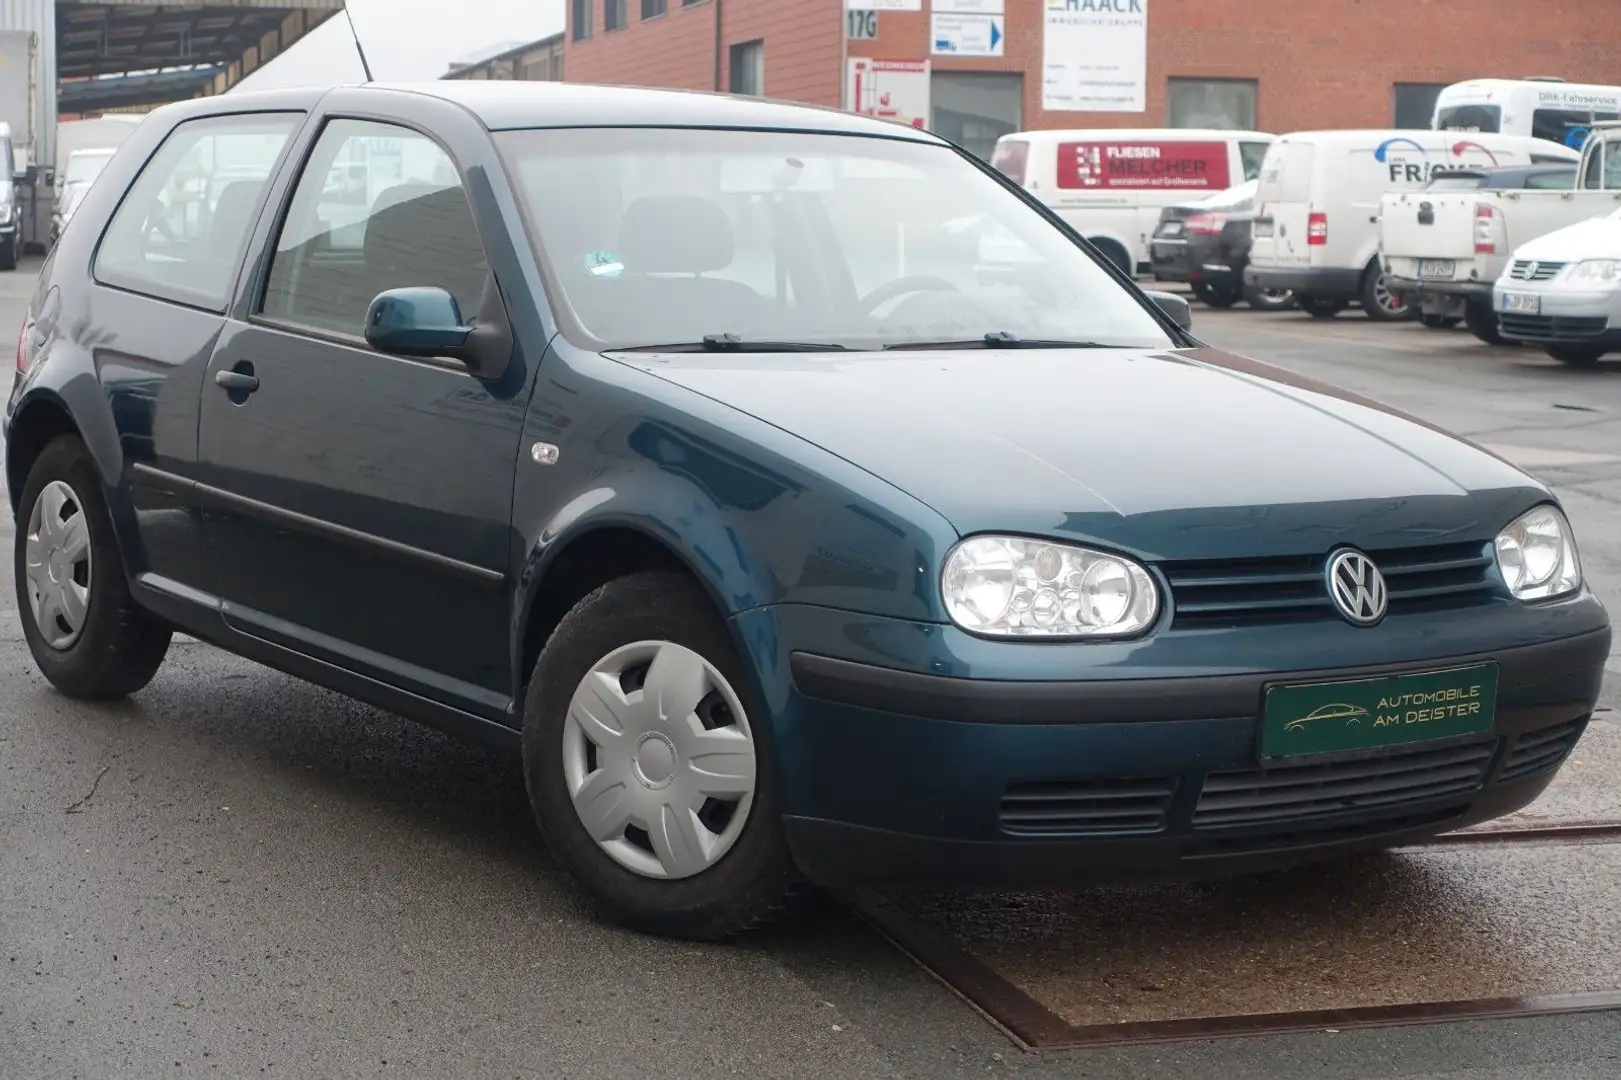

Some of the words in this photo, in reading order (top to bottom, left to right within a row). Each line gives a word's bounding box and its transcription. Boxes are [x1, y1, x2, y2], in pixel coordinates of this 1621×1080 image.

[1066, 0, 1142, 12] HAACK
[848, 10, 876, 37] 17G
[1106, 147, 1160, 158] FLIESEN
[1109, 160, 1207, 174] MELCHER
[1377, 685, 1481, 709] AUTOMOBILE
[1373, 714, 1400, 728] AM
[1405, 702, 1481, 724] DEISTER
